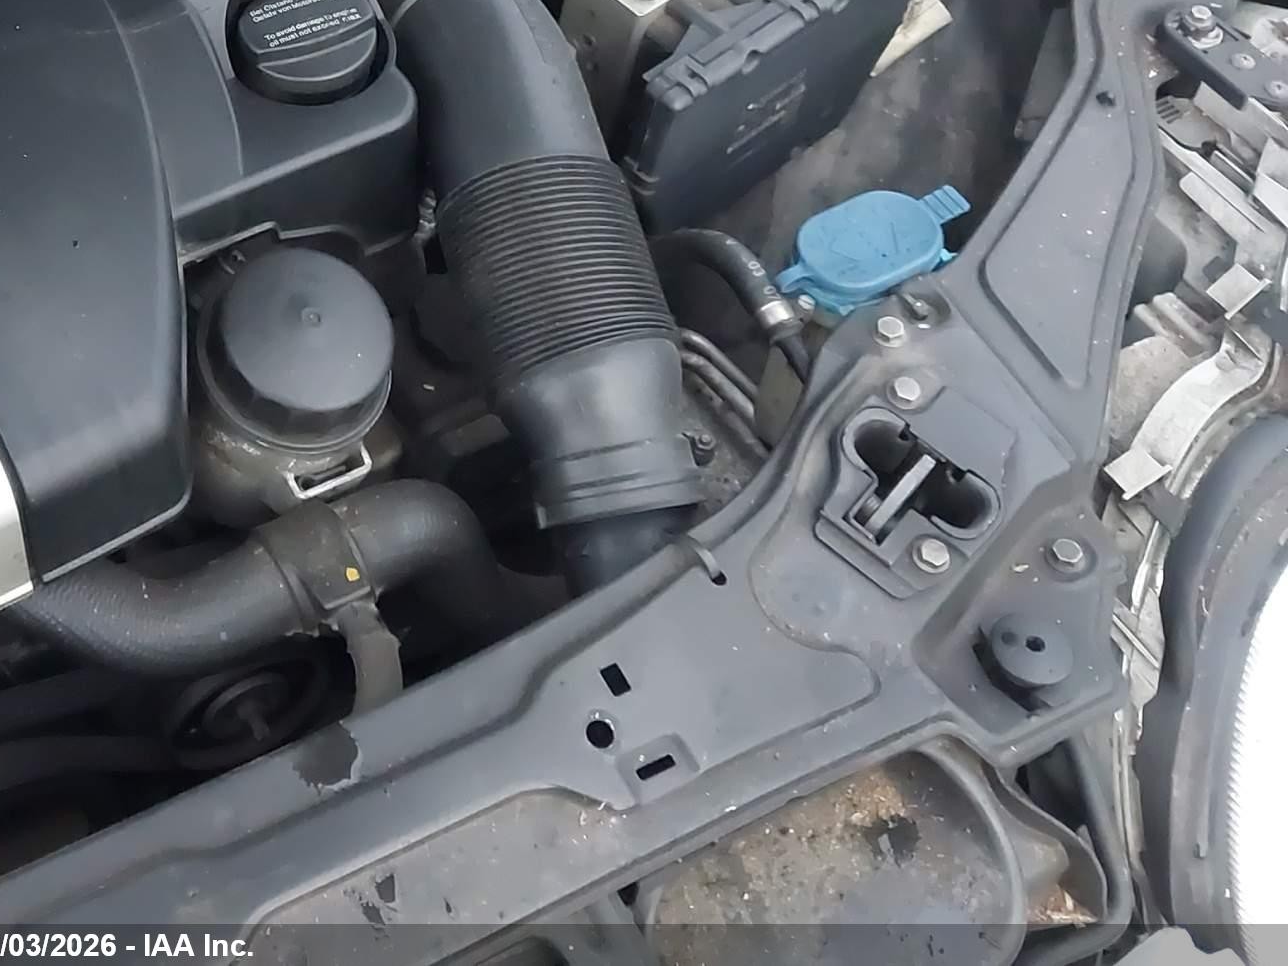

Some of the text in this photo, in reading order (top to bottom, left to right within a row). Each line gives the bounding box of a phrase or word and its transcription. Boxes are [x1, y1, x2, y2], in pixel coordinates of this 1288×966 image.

[277, 5, 292, 13] von
[269, 39, 280, 47] oil
[279, 32, 299, 44] must
[298, 27, 312, 36] not
[312, 18, 340, 31] exceed
[275, 25, 296, 37] avoid
[296, 17, 325, 30] damage
